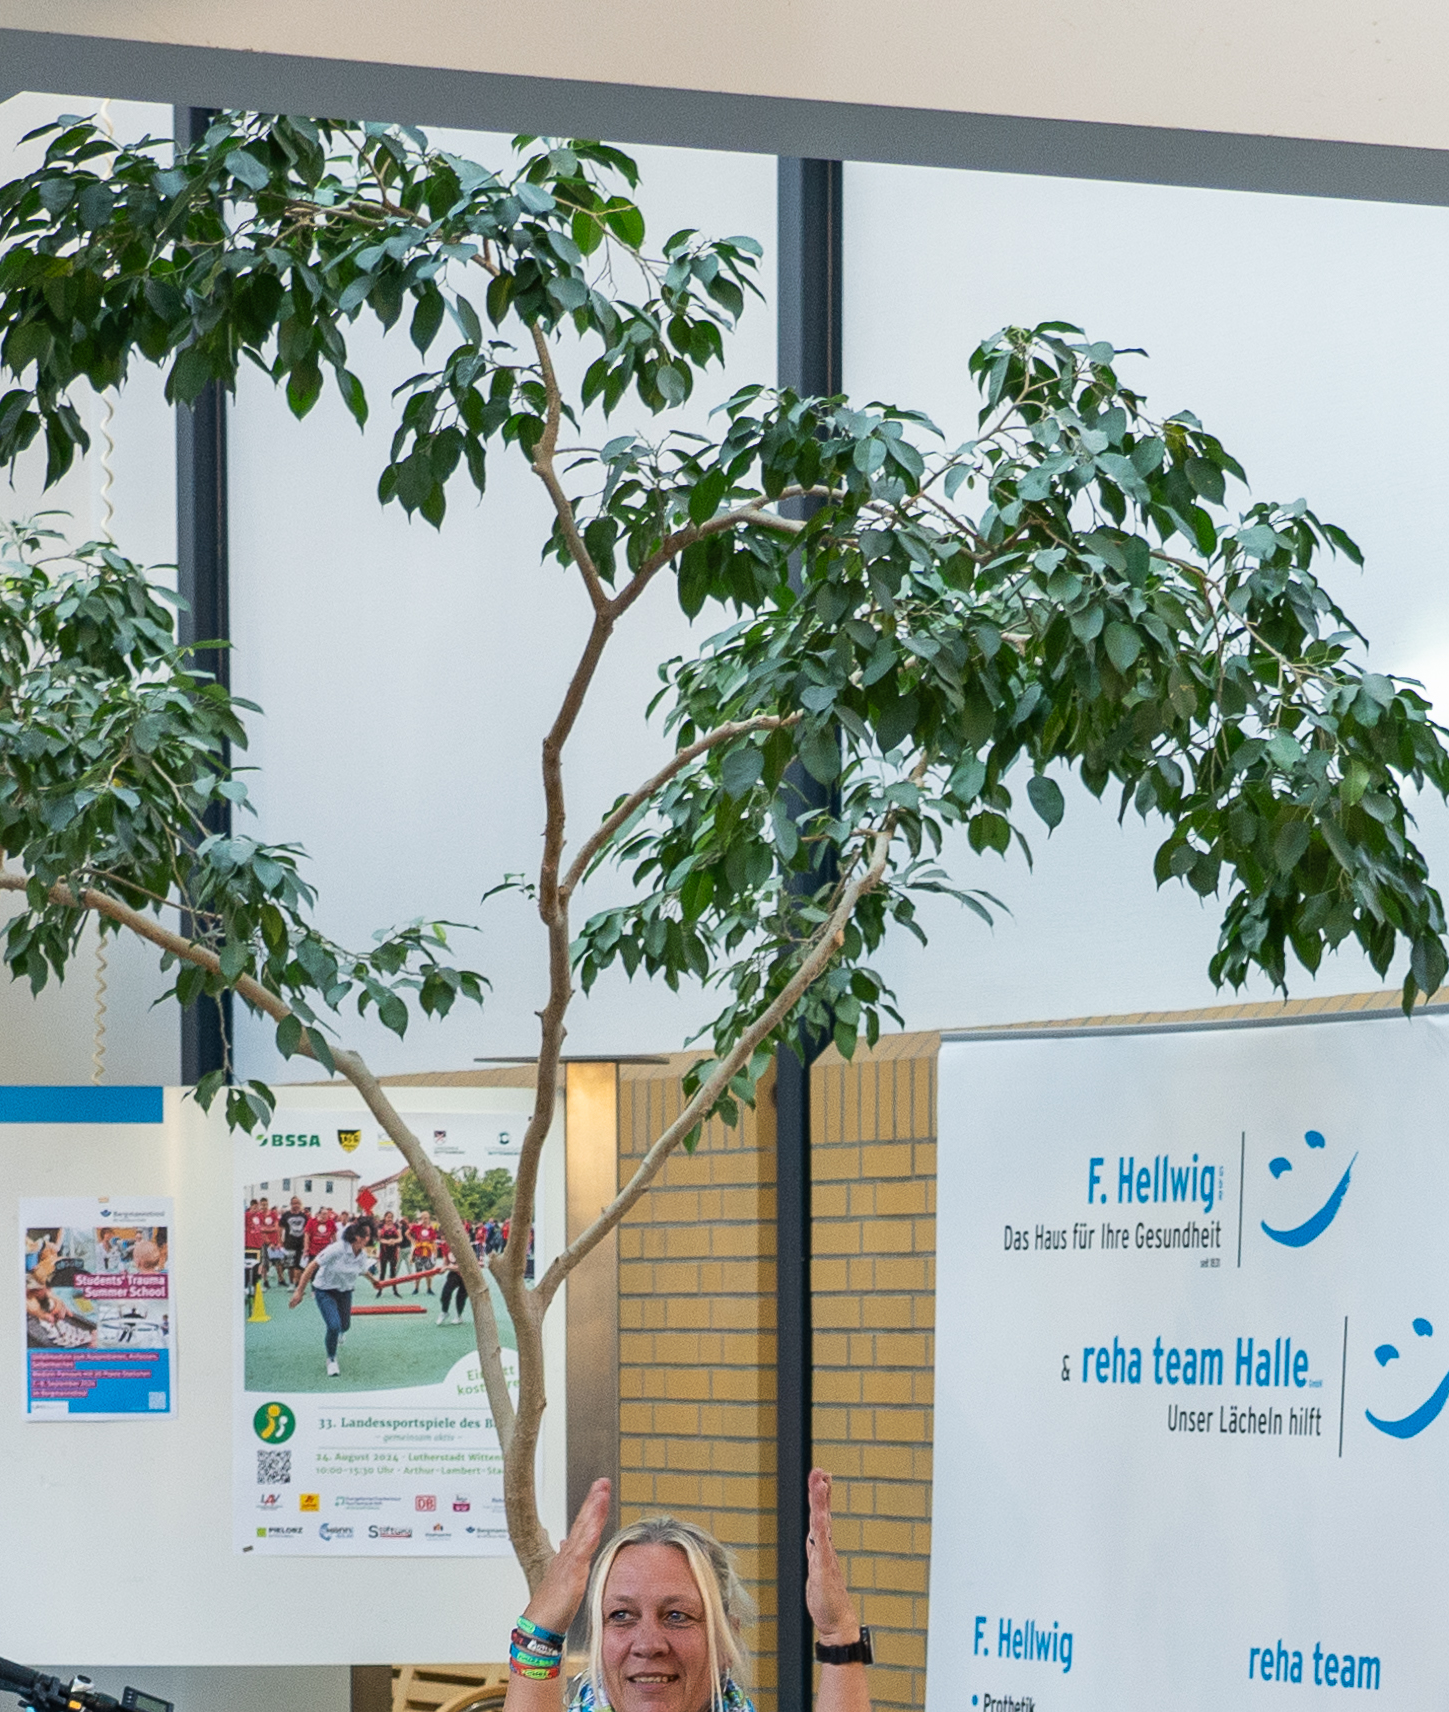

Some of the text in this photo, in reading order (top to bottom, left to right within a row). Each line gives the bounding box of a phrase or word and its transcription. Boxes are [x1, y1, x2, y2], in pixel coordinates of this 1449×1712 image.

[272, 1134, 321, 1147] BSSA
[1087, 1157, 1108, 1206] F.
[1117, 1153, 1216, 1214] Hellwig
[1003, 1221, 1221, 1251] Das Haus für Ihre Gesundheit
[84, 1286, 166, 1298] Summer School
[128, 1274, 165, 1285] Trauma
[1061, 1355, 1071, 1383] &
[1081, 1336, 1142, 1385] reha
[1152, 1337, 1224, 1387] team
[1235, 1337, 1309, 1388] Halle
[318, 1419, 336, 1430] 33.
[341, 1417, 455, 1430] Landessportspiele
[460, 1418, 480, 1428] des
[1167, 1404, 1322, 1437] Unser Lächeln hilft
[334, 1453, 369, 1463] August
[408, 1452, 465, 1461] Lutherstadt
[468, 1453, 504, 1461] Witten
[973, 1616, 1073, 1673] F. Hellwig
[1249, 1639, 1381, 1690] reha team
